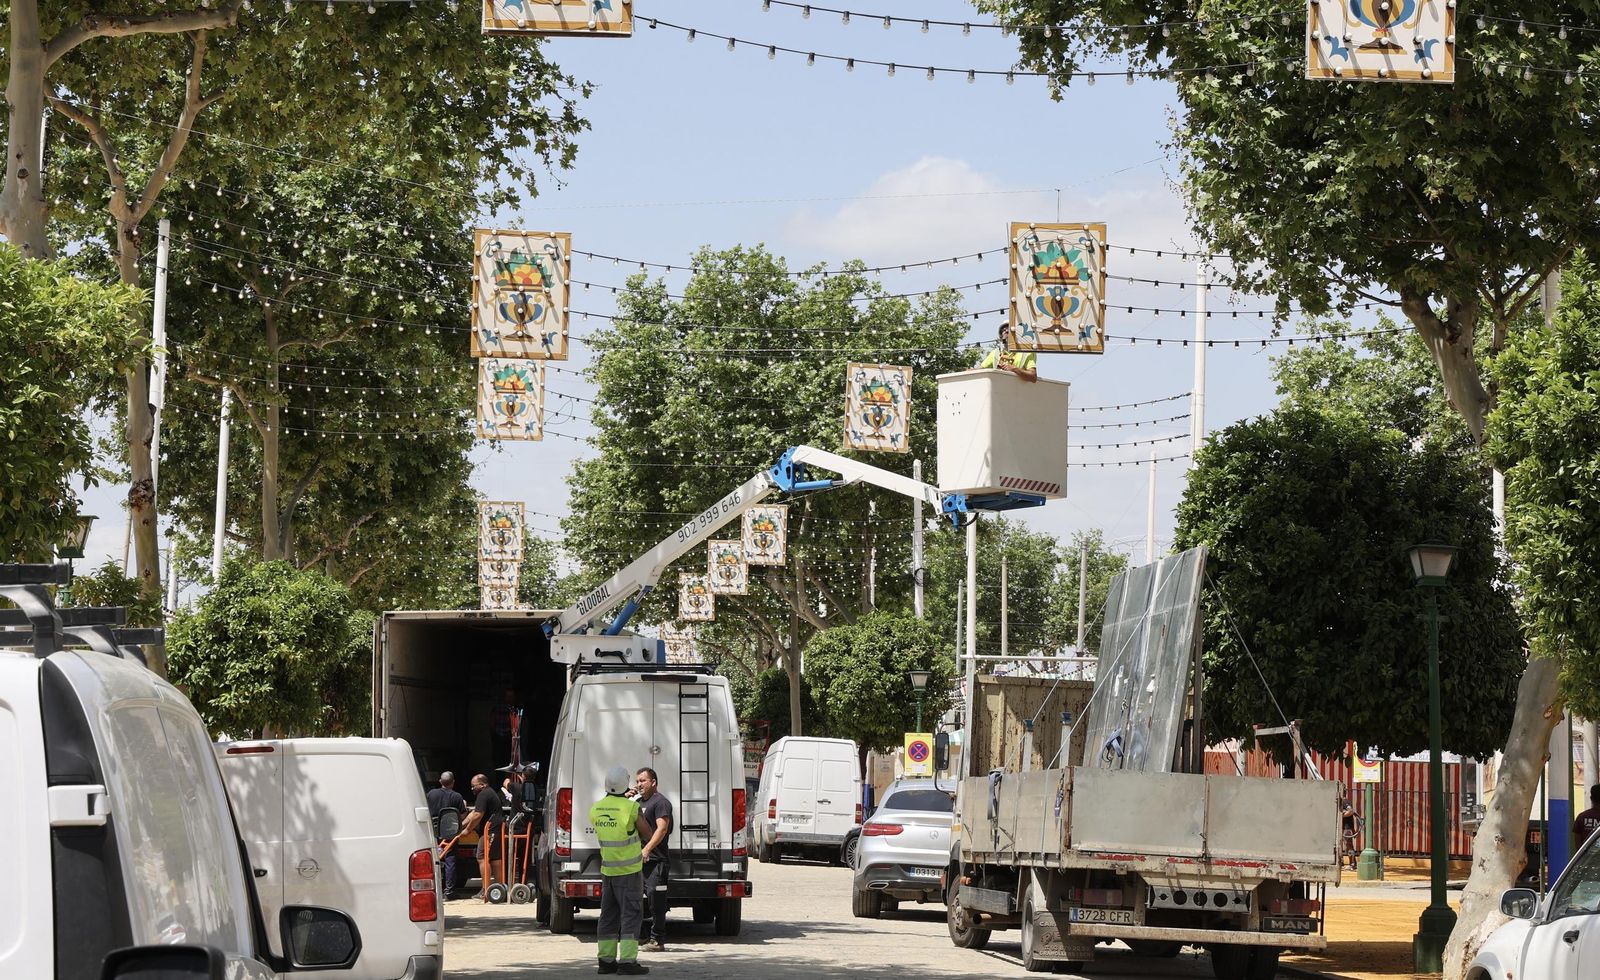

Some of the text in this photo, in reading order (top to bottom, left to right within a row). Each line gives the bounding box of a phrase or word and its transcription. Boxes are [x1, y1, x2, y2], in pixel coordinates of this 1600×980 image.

[677, 491, 742, 543] 902 999 646
[576, 585, 611, 616] GLOOBAL
[915, 868, 936, 877] 0313
[1078, 909, 1131, 923] 3728 CFR
[1271, 919, 1310, 930] MAN
